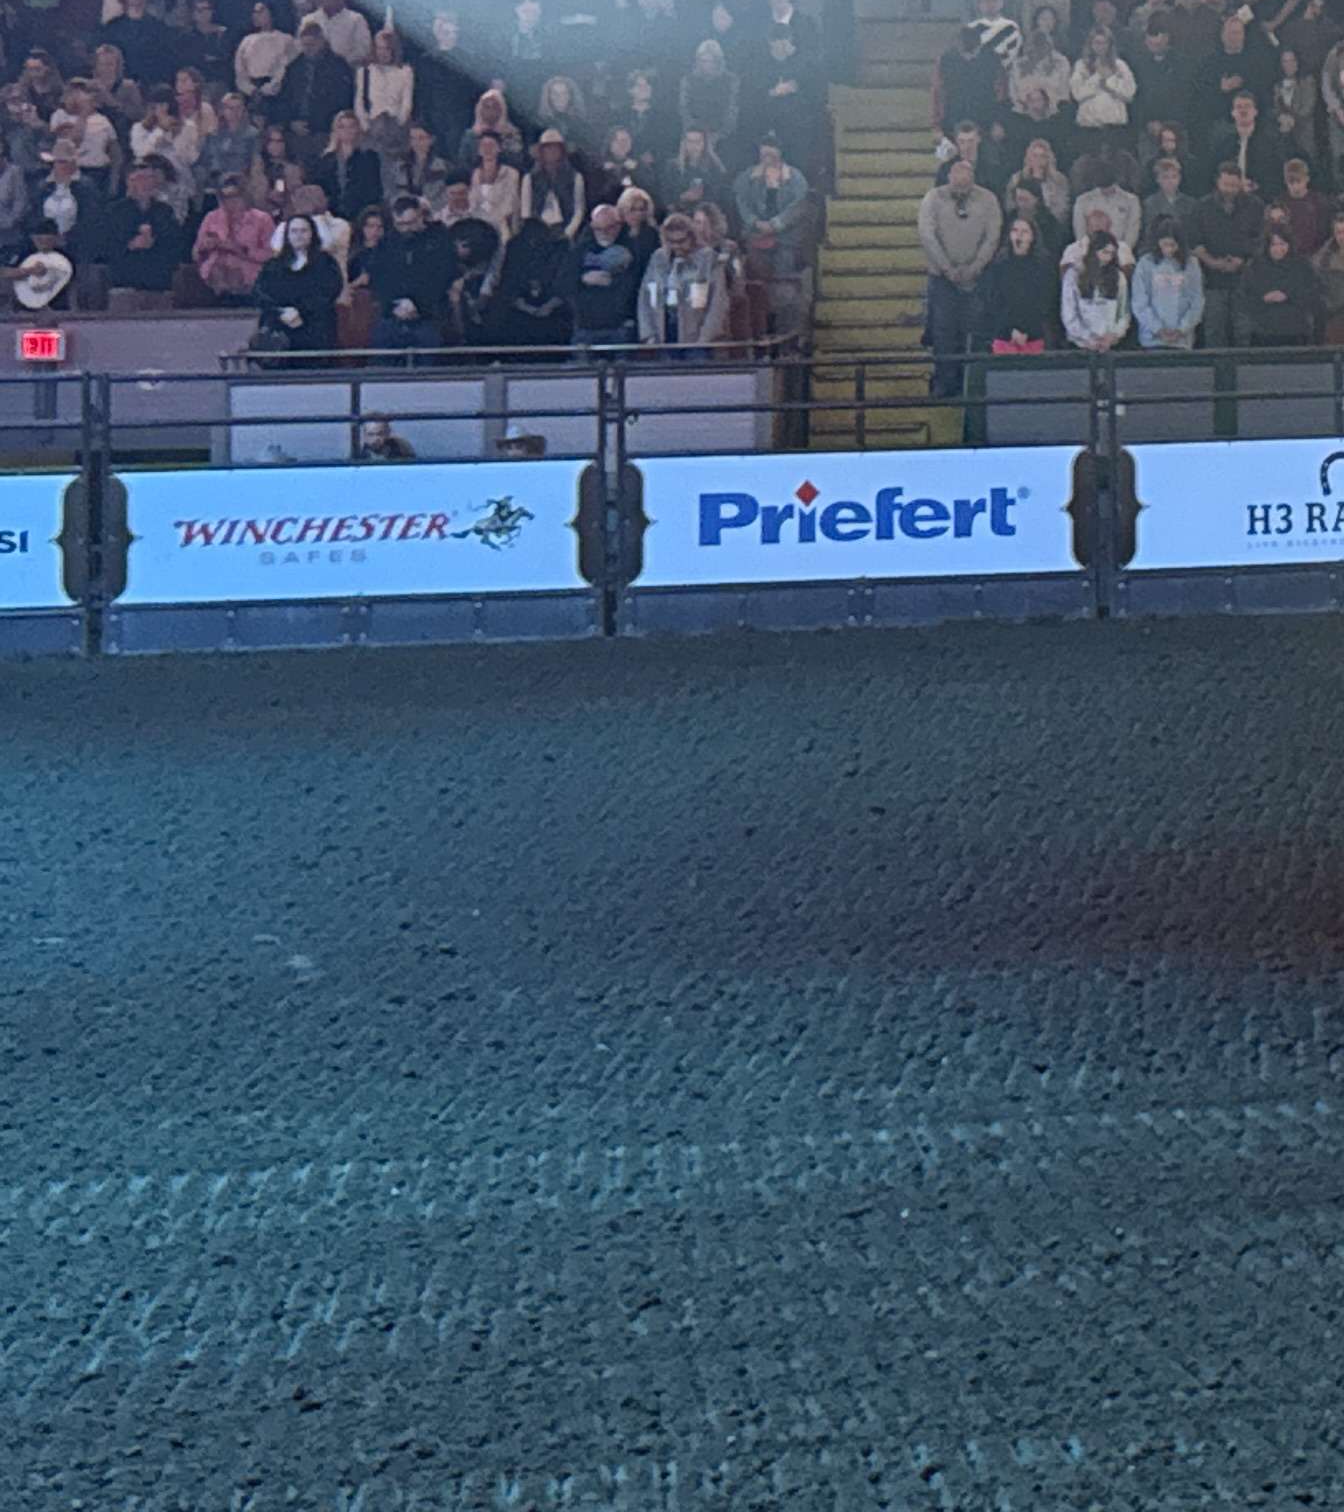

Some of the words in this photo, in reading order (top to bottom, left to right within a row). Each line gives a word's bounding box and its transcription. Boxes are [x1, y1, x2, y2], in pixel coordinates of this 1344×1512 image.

[173, 512, 451, 548] WINCHESTER
[698, 479, 1018, 547] Priefert
[1246, 503, 1293, 536] H3
[259, 548, 368, 566] SAFES
